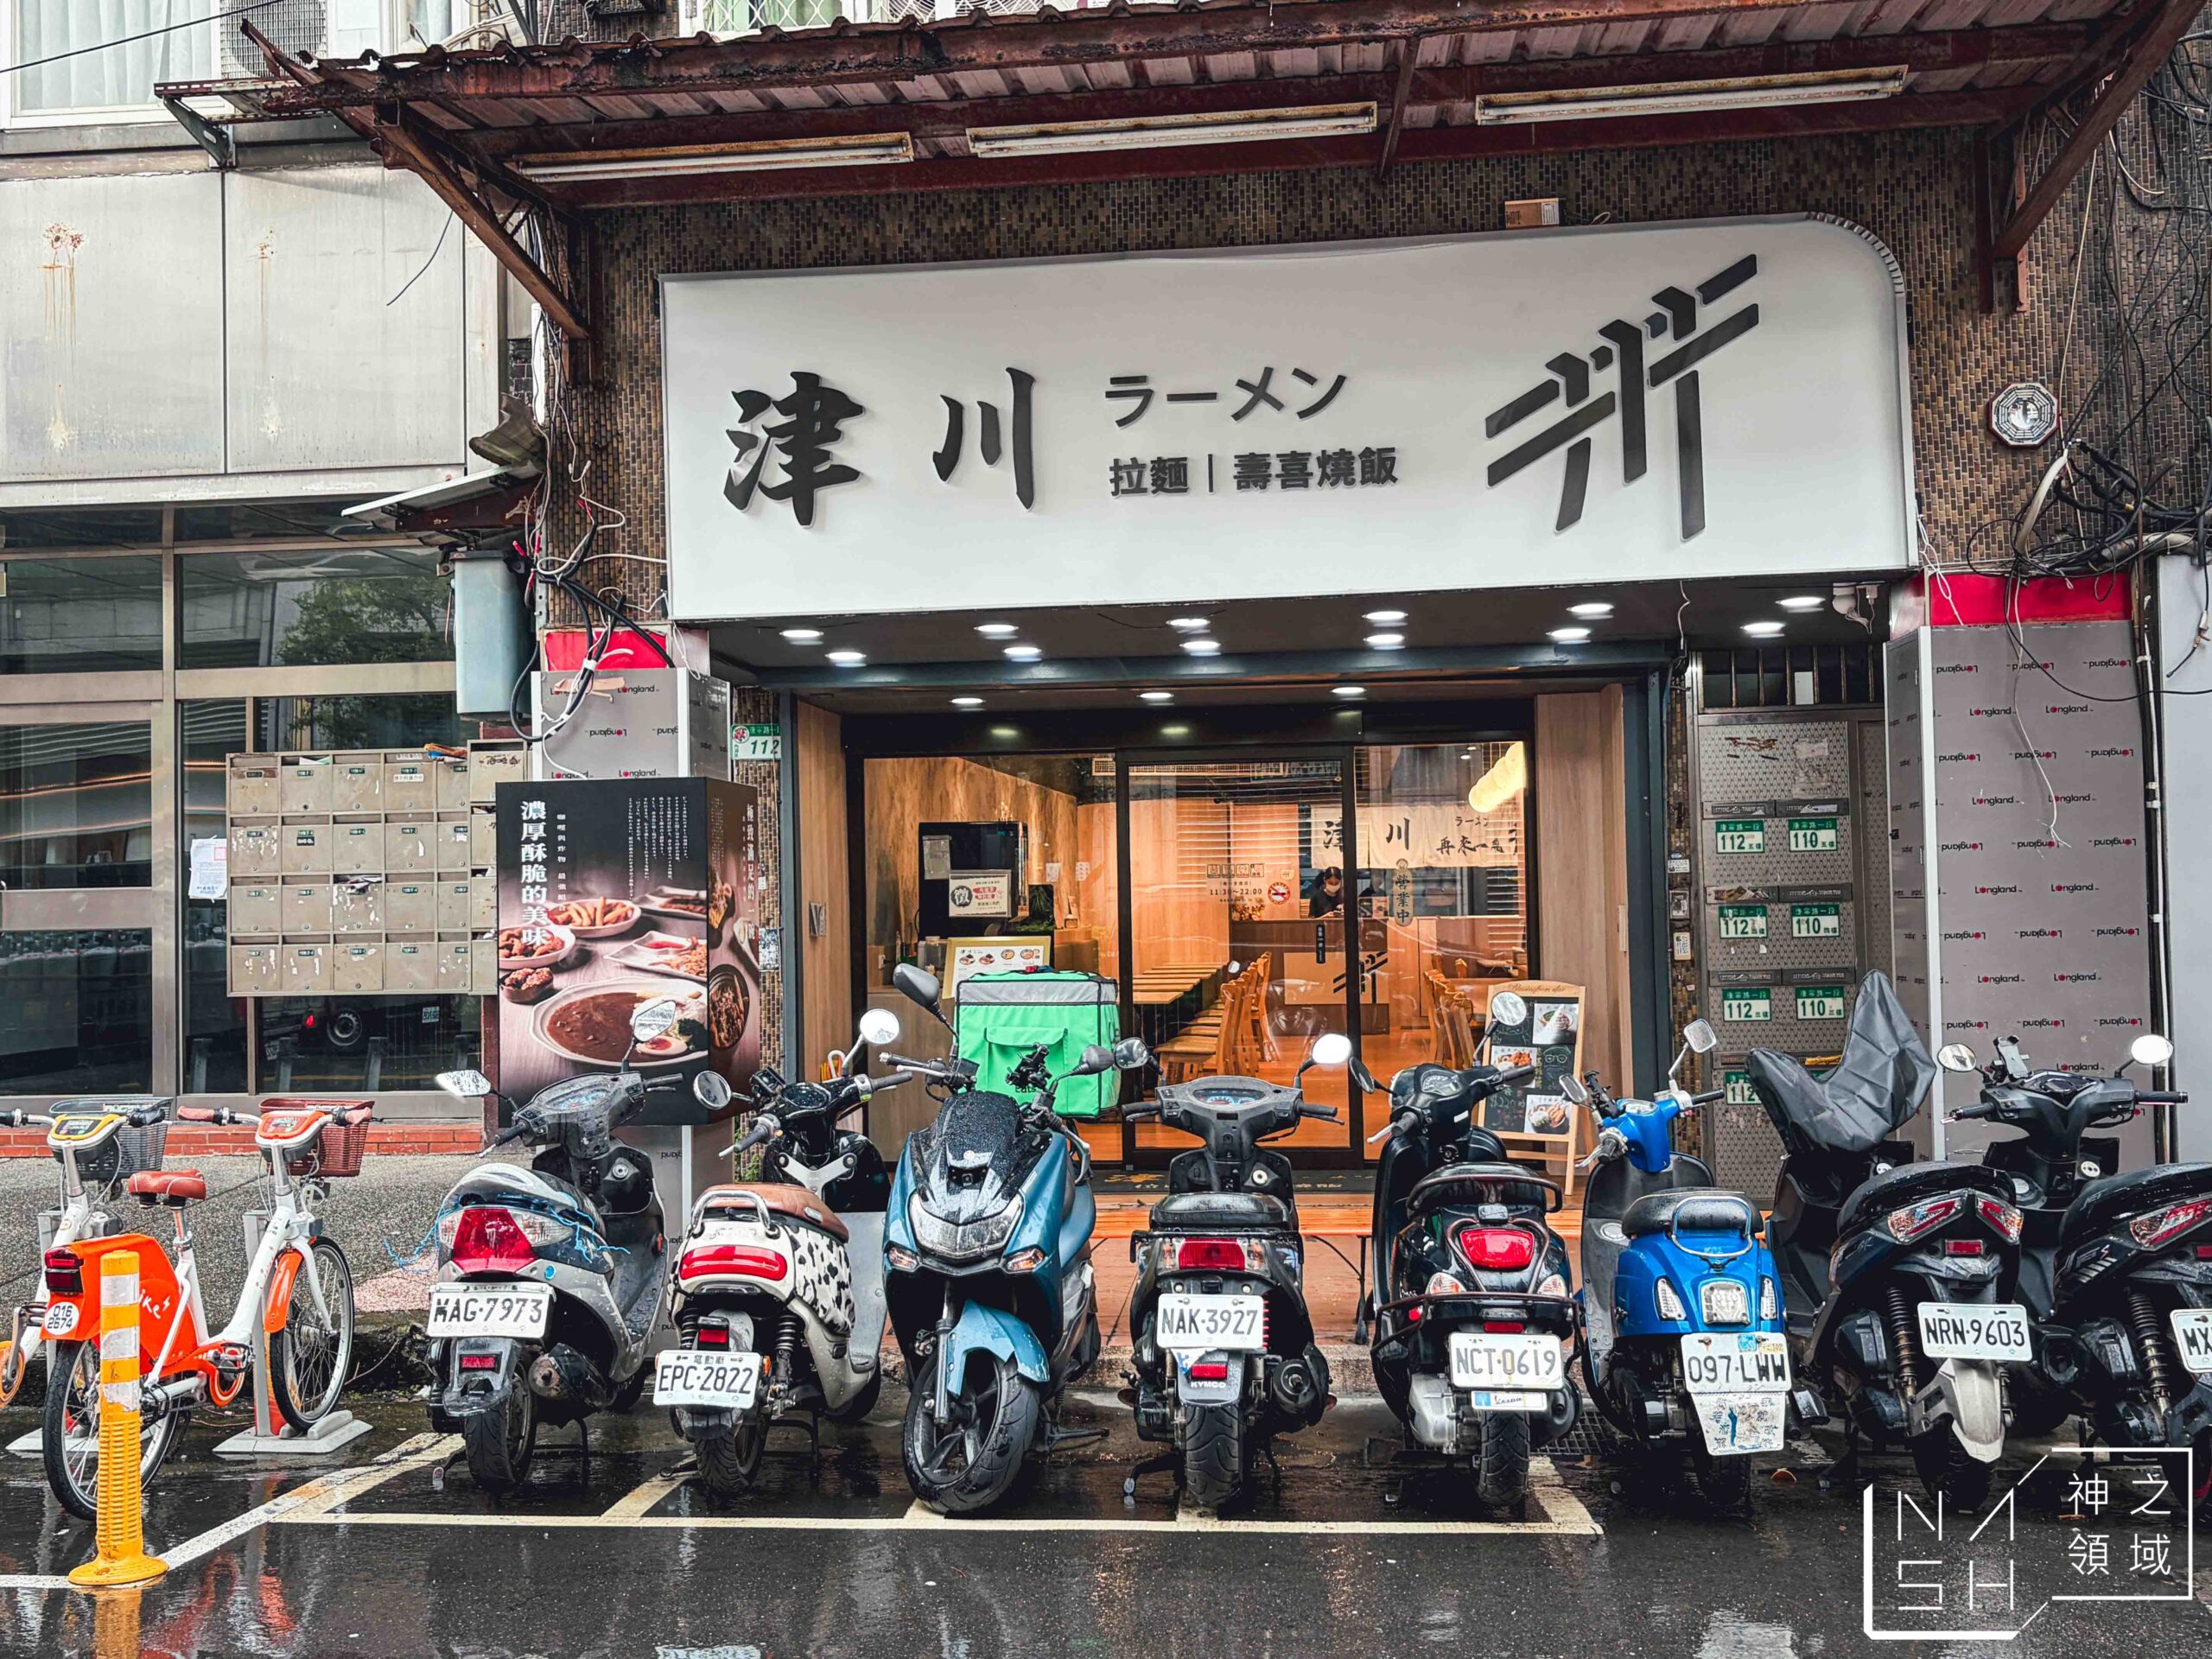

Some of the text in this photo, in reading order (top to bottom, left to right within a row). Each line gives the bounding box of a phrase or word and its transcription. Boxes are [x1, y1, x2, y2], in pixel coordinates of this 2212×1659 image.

[1105, 366, 1348, 429] ラーメン
[723, 367, 1037, 529] 津川
[1109, 447, 1399, 498] 拉麵 壽喜燒飯
[751, 740, 779, 753] 112
[1721, 834, 1745, 849] 112
[1794, 831, 1818, 848] 110
[520, 800, 548, 946] 濃厚酥脆的美味
[1395, 874, 1411, 924] 營業中
[1724, 918, 1748, 935] 112
[1796, 918, 1821, 933] 110
[1727, 1003, 1751, 1019] 112
[1801, 1000, 1825, 1016] 110
[1731, 1089, 1756, 1102] 112
[54, 1306, 73, 1317] 016
